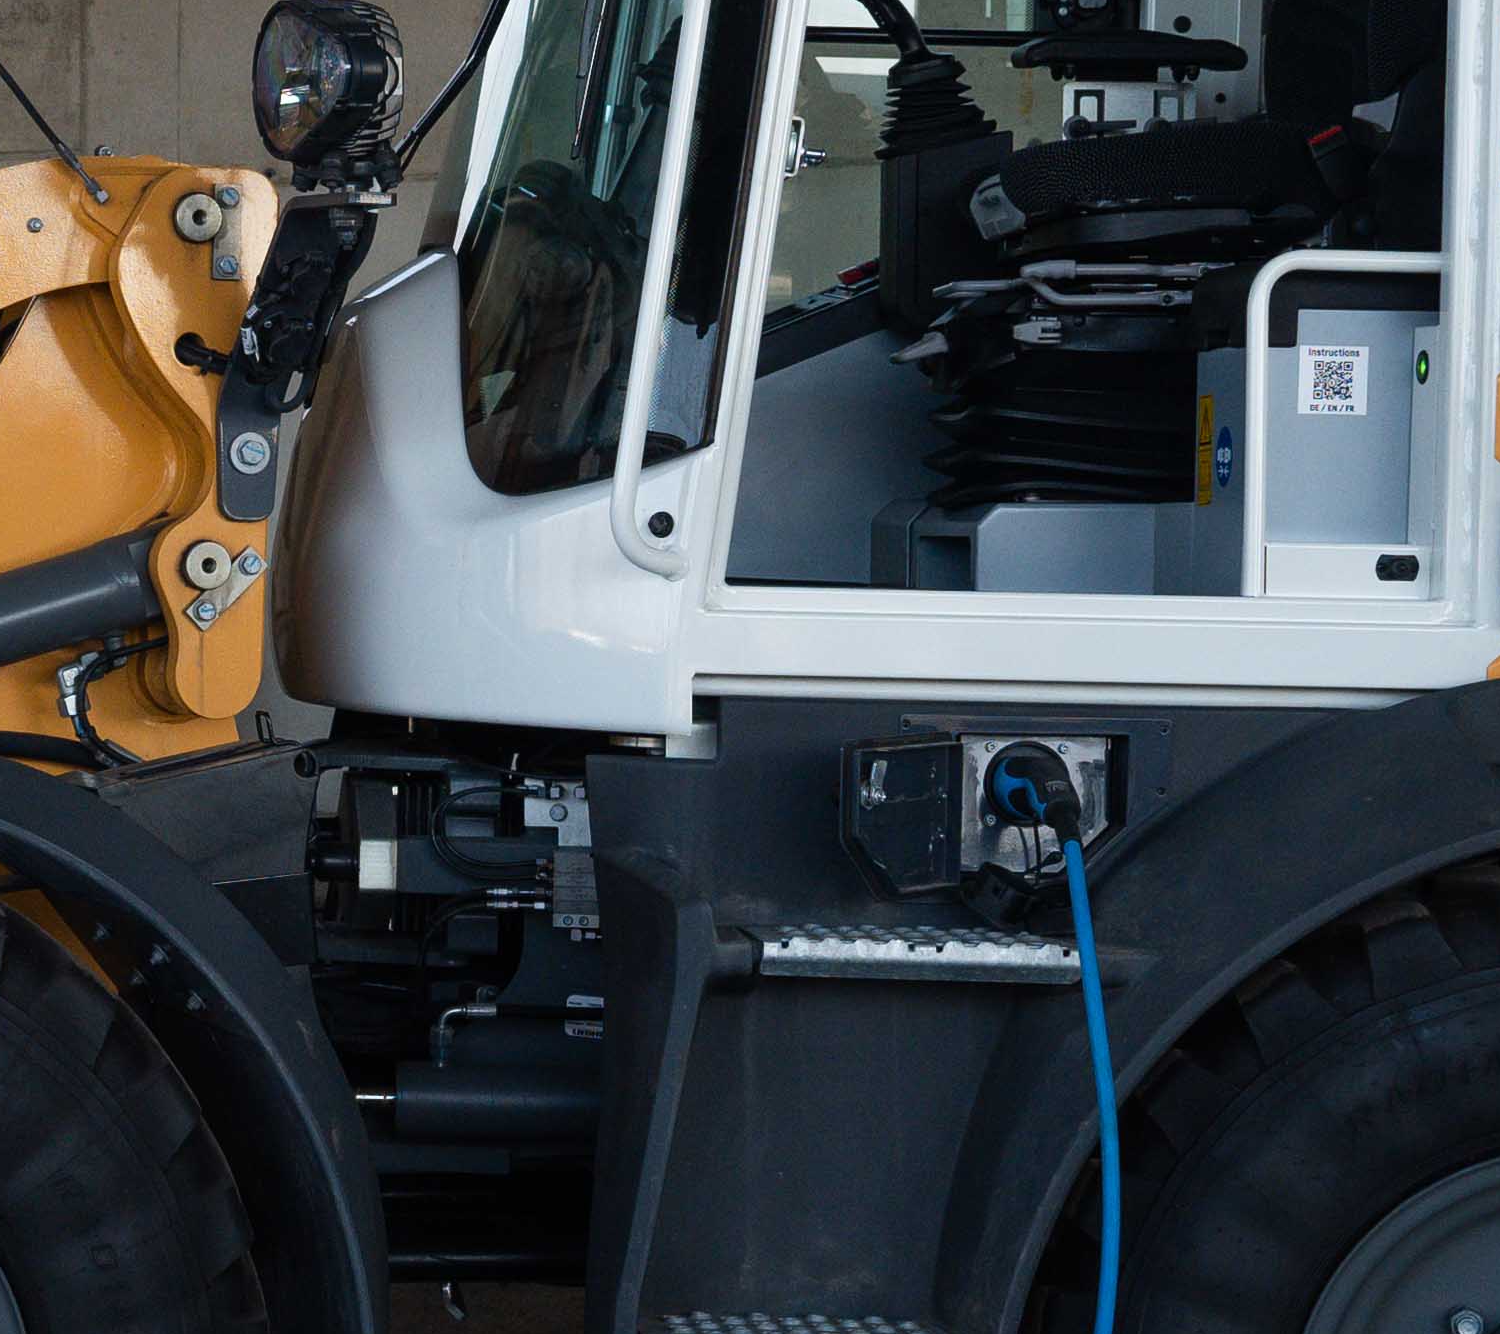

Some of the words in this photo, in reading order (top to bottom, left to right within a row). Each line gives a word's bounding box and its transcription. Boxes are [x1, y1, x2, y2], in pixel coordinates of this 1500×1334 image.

[1308, 348, 1361, 358] Instructions
[1309, 404, 1320, 412] DE
[1327, 404, 1338, 412] EN
